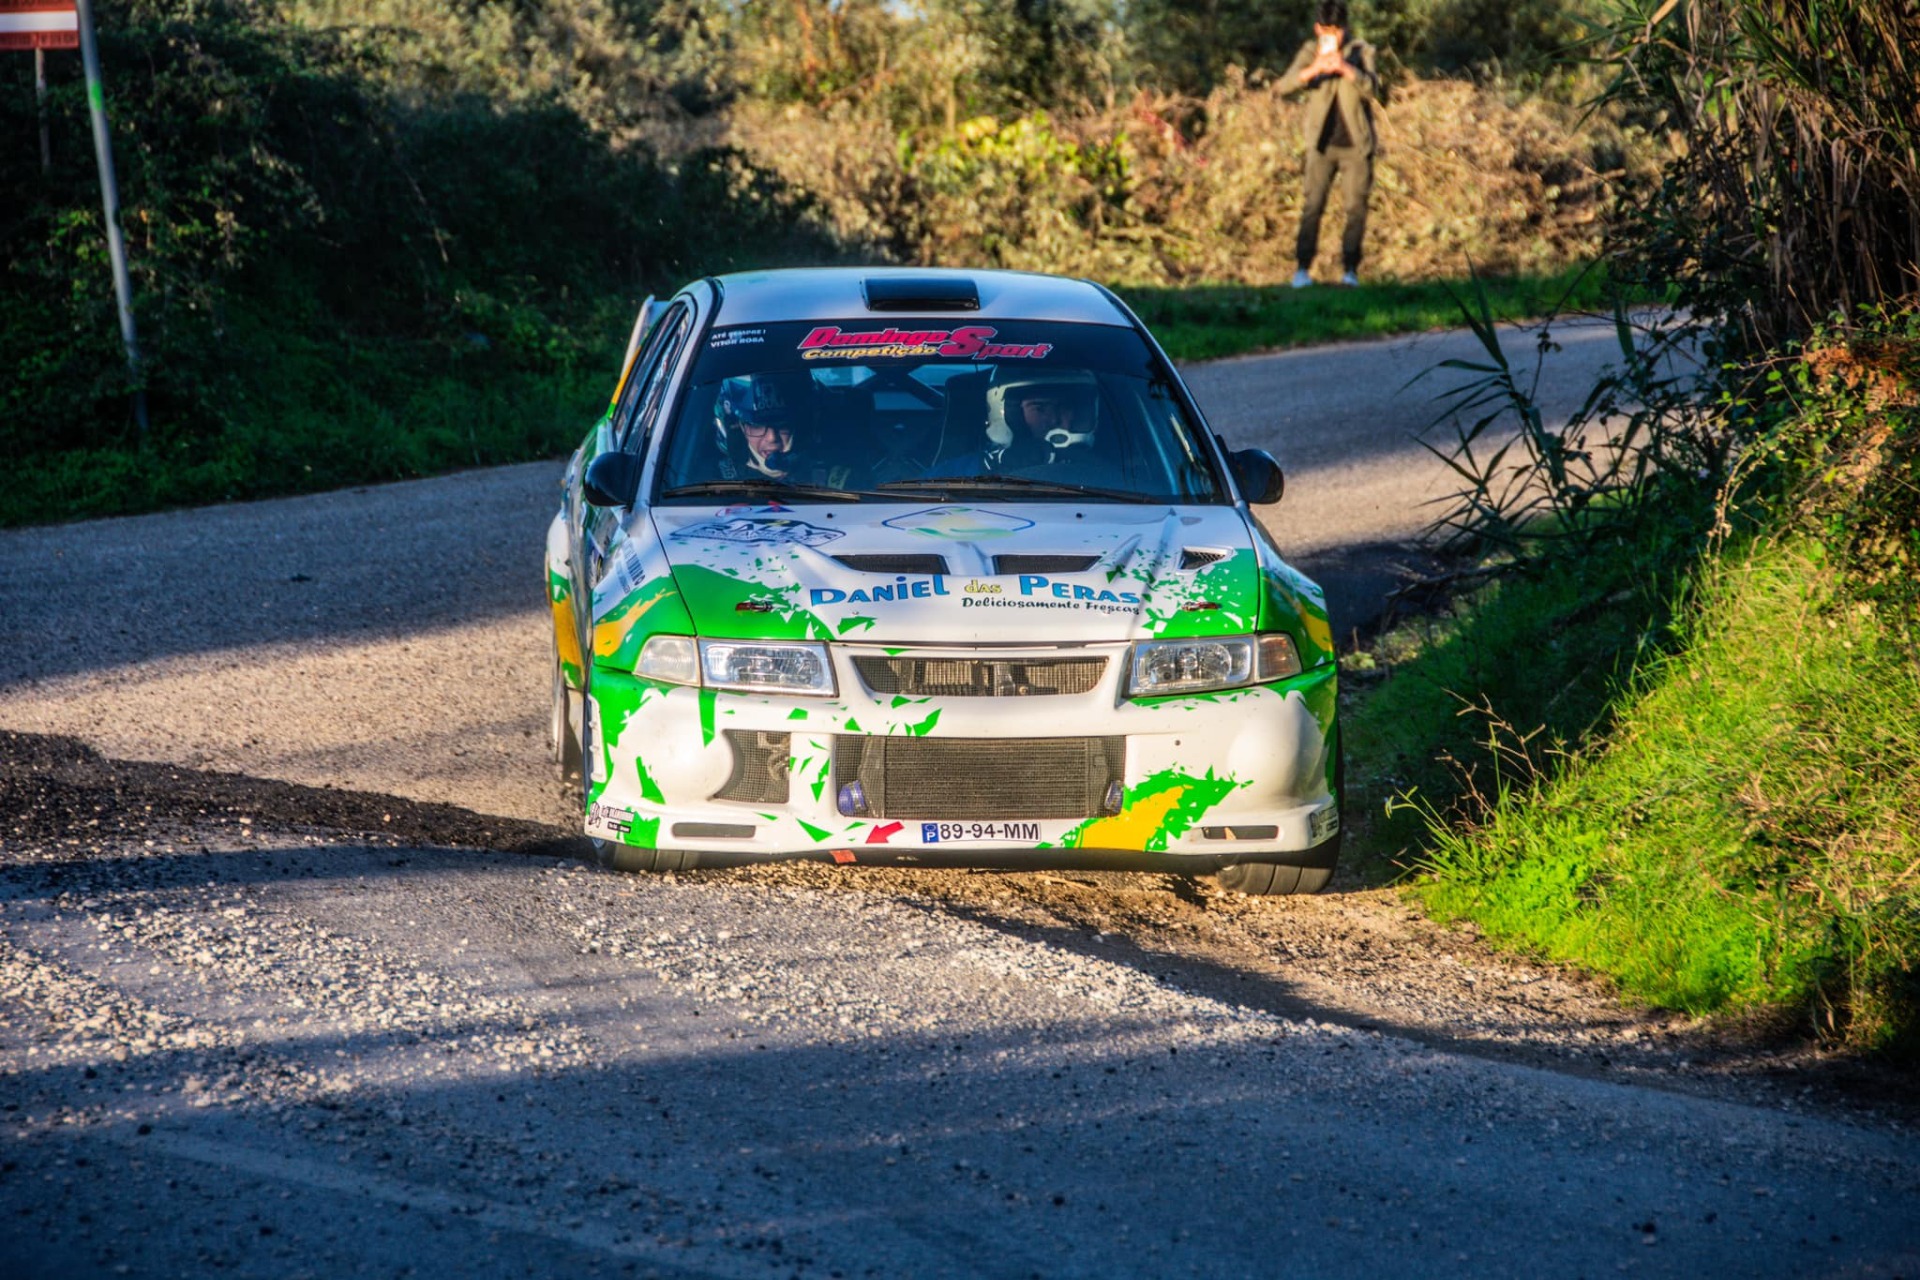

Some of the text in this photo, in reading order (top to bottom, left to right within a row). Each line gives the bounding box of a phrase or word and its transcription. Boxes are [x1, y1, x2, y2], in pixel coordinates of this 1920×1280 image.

[739, 336, 765, 344] ROSA
[797, 326, 1053, 360] Domingo Sport
[802, 345, 937, 360] Competição
[1019, 574, 1141, 604] PERAS
[962, 597, 1141, 615] Deliciosamente Frescas
[926, 823, 1039, 842] P 89-94-MM
